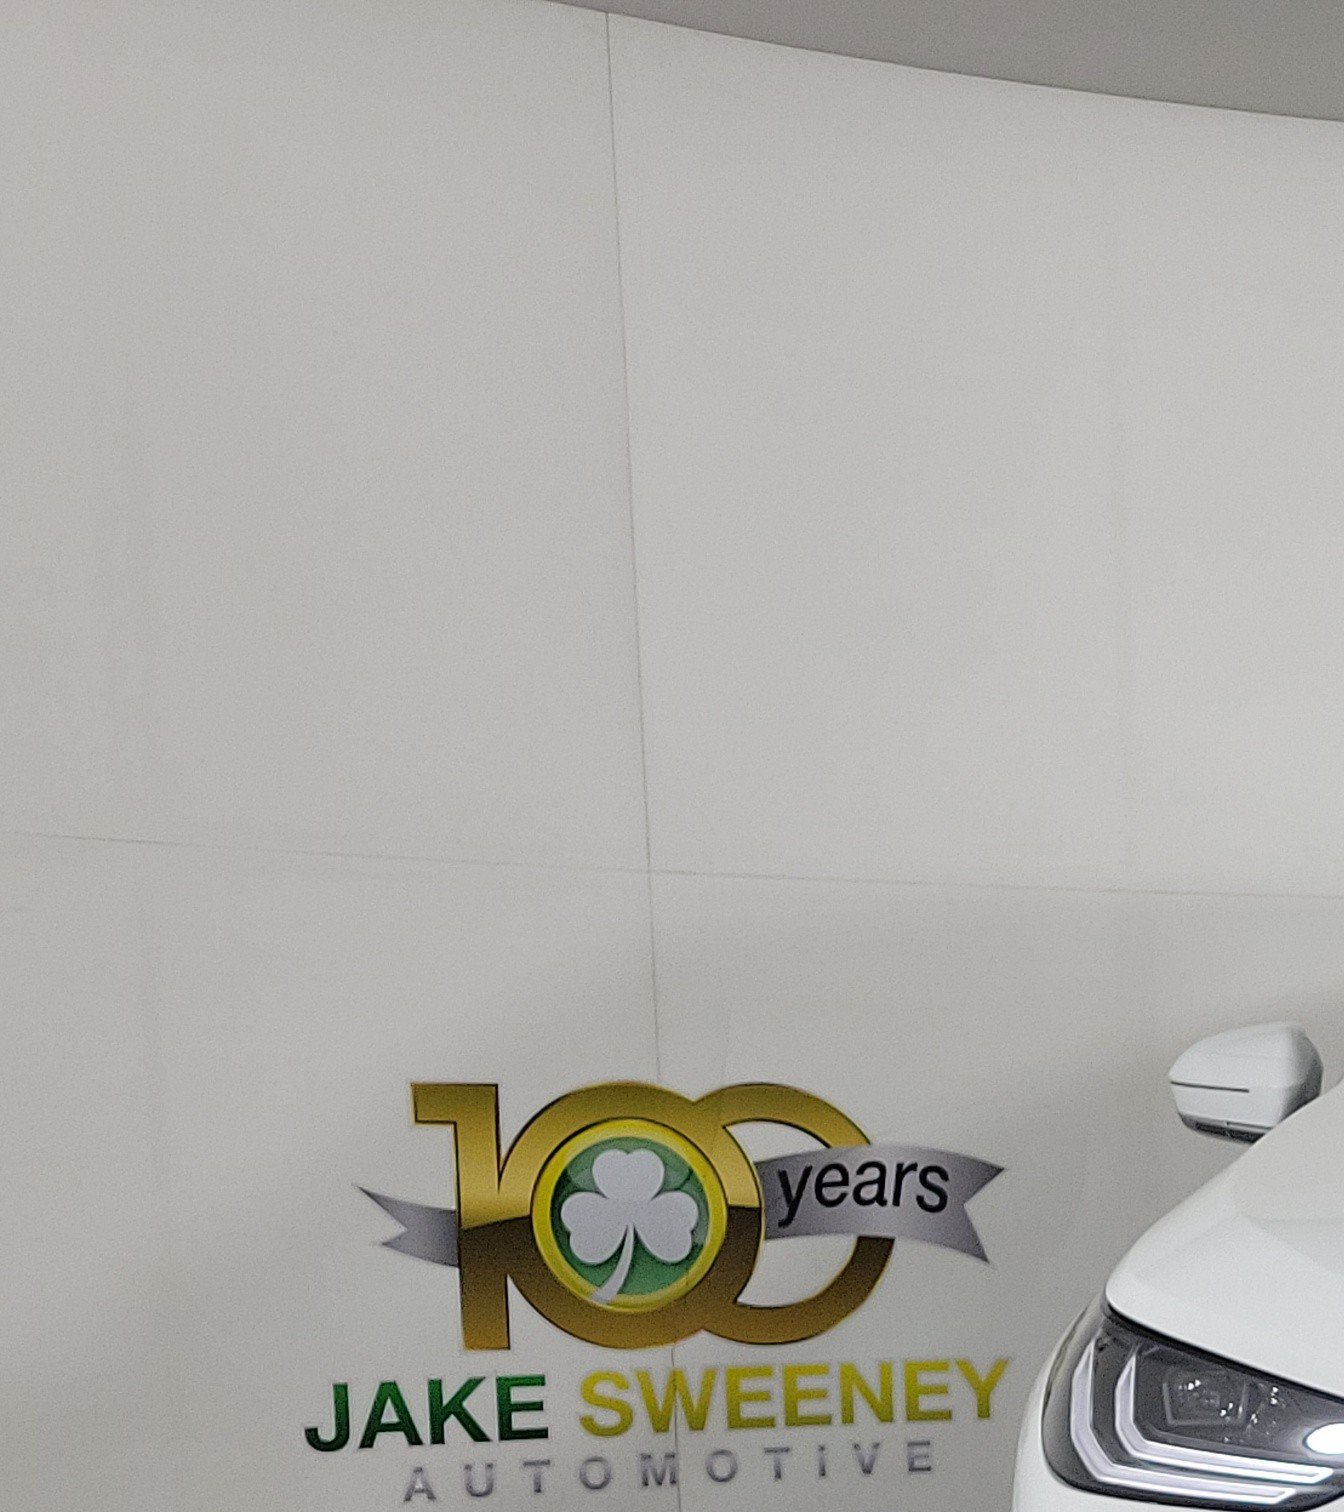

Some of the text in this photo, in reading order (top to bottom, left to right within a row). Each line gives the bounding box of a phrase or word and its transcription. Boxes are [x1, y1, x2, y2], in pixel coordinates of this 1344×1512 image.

[411, 1081, 950, 1351] 100 years
[304, 1358, 1010, 1453] JAKE SWEENEY
[403, 1441, 933, 1503] AUTOMOTIVE
